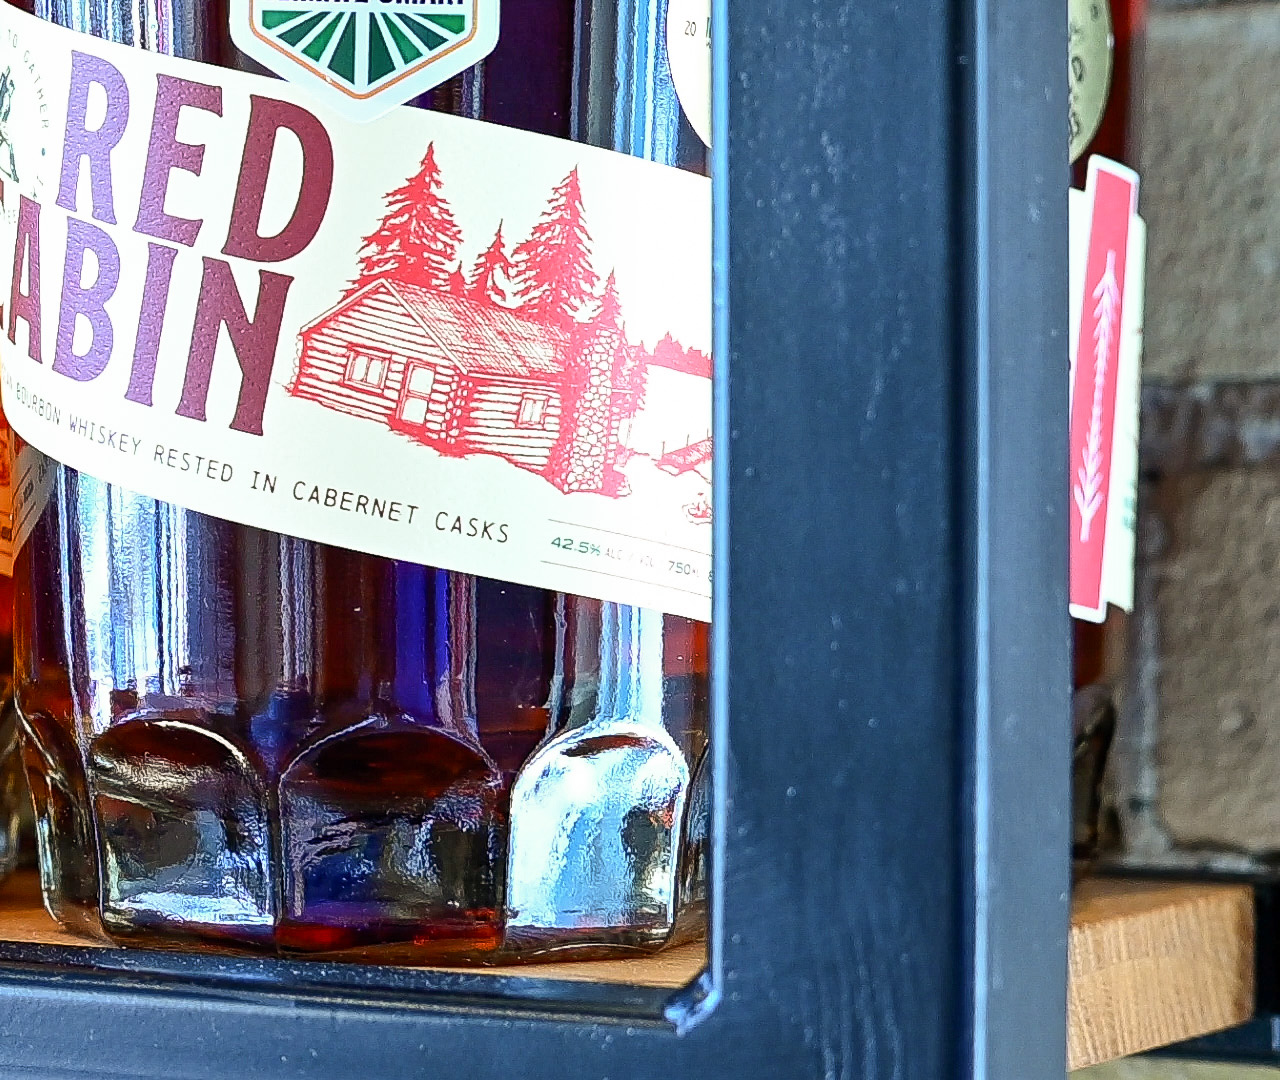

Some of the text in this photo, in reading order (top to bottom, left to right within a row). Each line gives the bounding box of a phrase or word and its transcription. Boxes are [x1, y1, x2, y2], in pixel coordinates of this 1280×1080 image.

[684, 20, 696, 37] 20
[55, 50, 334, 264] RED
[16, 382, 508, 543] BOURBON WHISKEY RESTED IN CABERNET CASKS
[551, 537, 600, 557] 42.5%
